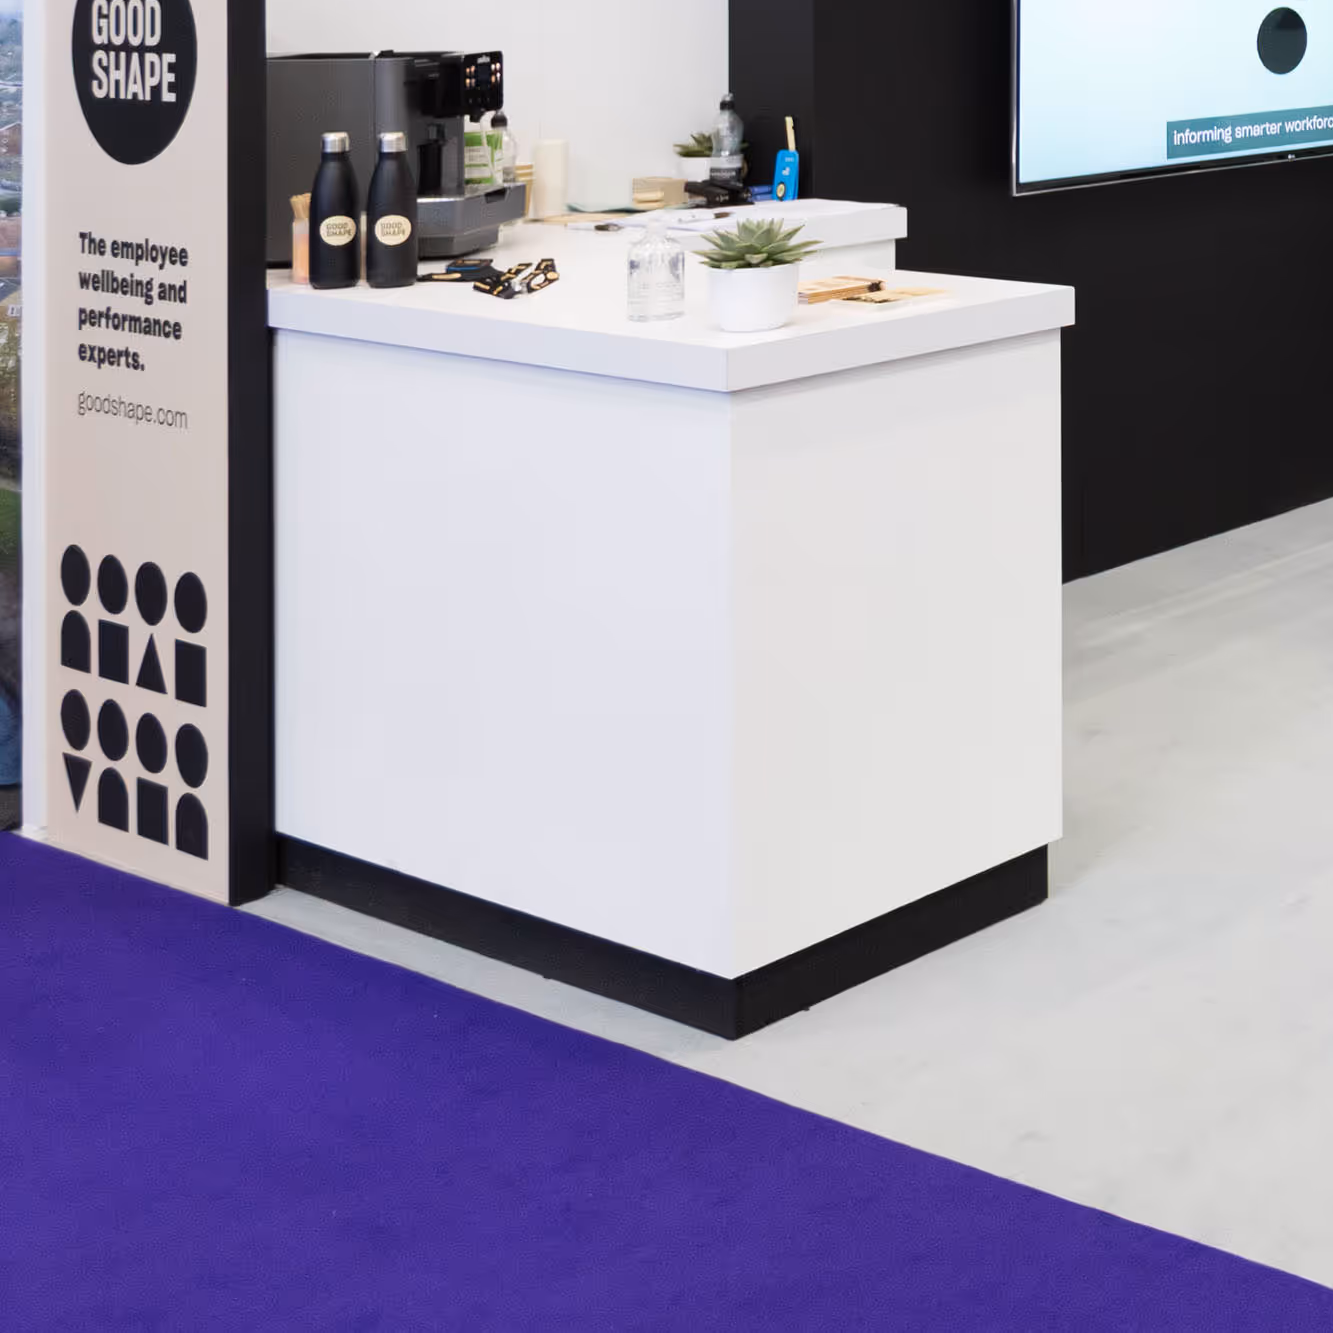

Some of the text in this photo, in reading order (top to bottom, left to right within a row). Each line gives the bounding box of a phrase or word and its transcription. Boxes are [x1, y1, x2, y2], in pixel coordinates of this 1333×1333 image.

[91, 49, 177, 103] SHAPE
[1173, 125, 1233, 145] informing
[1235, 120, 1282, 139] smarter
[79, 231, 189, 270] The employee
[78, 269, 188, 306] wellbeing and
[78, 306, 183, 341] performance
[78, 342, 145, 372] experts.
[77, 391, 188, 430] goodshape.com
